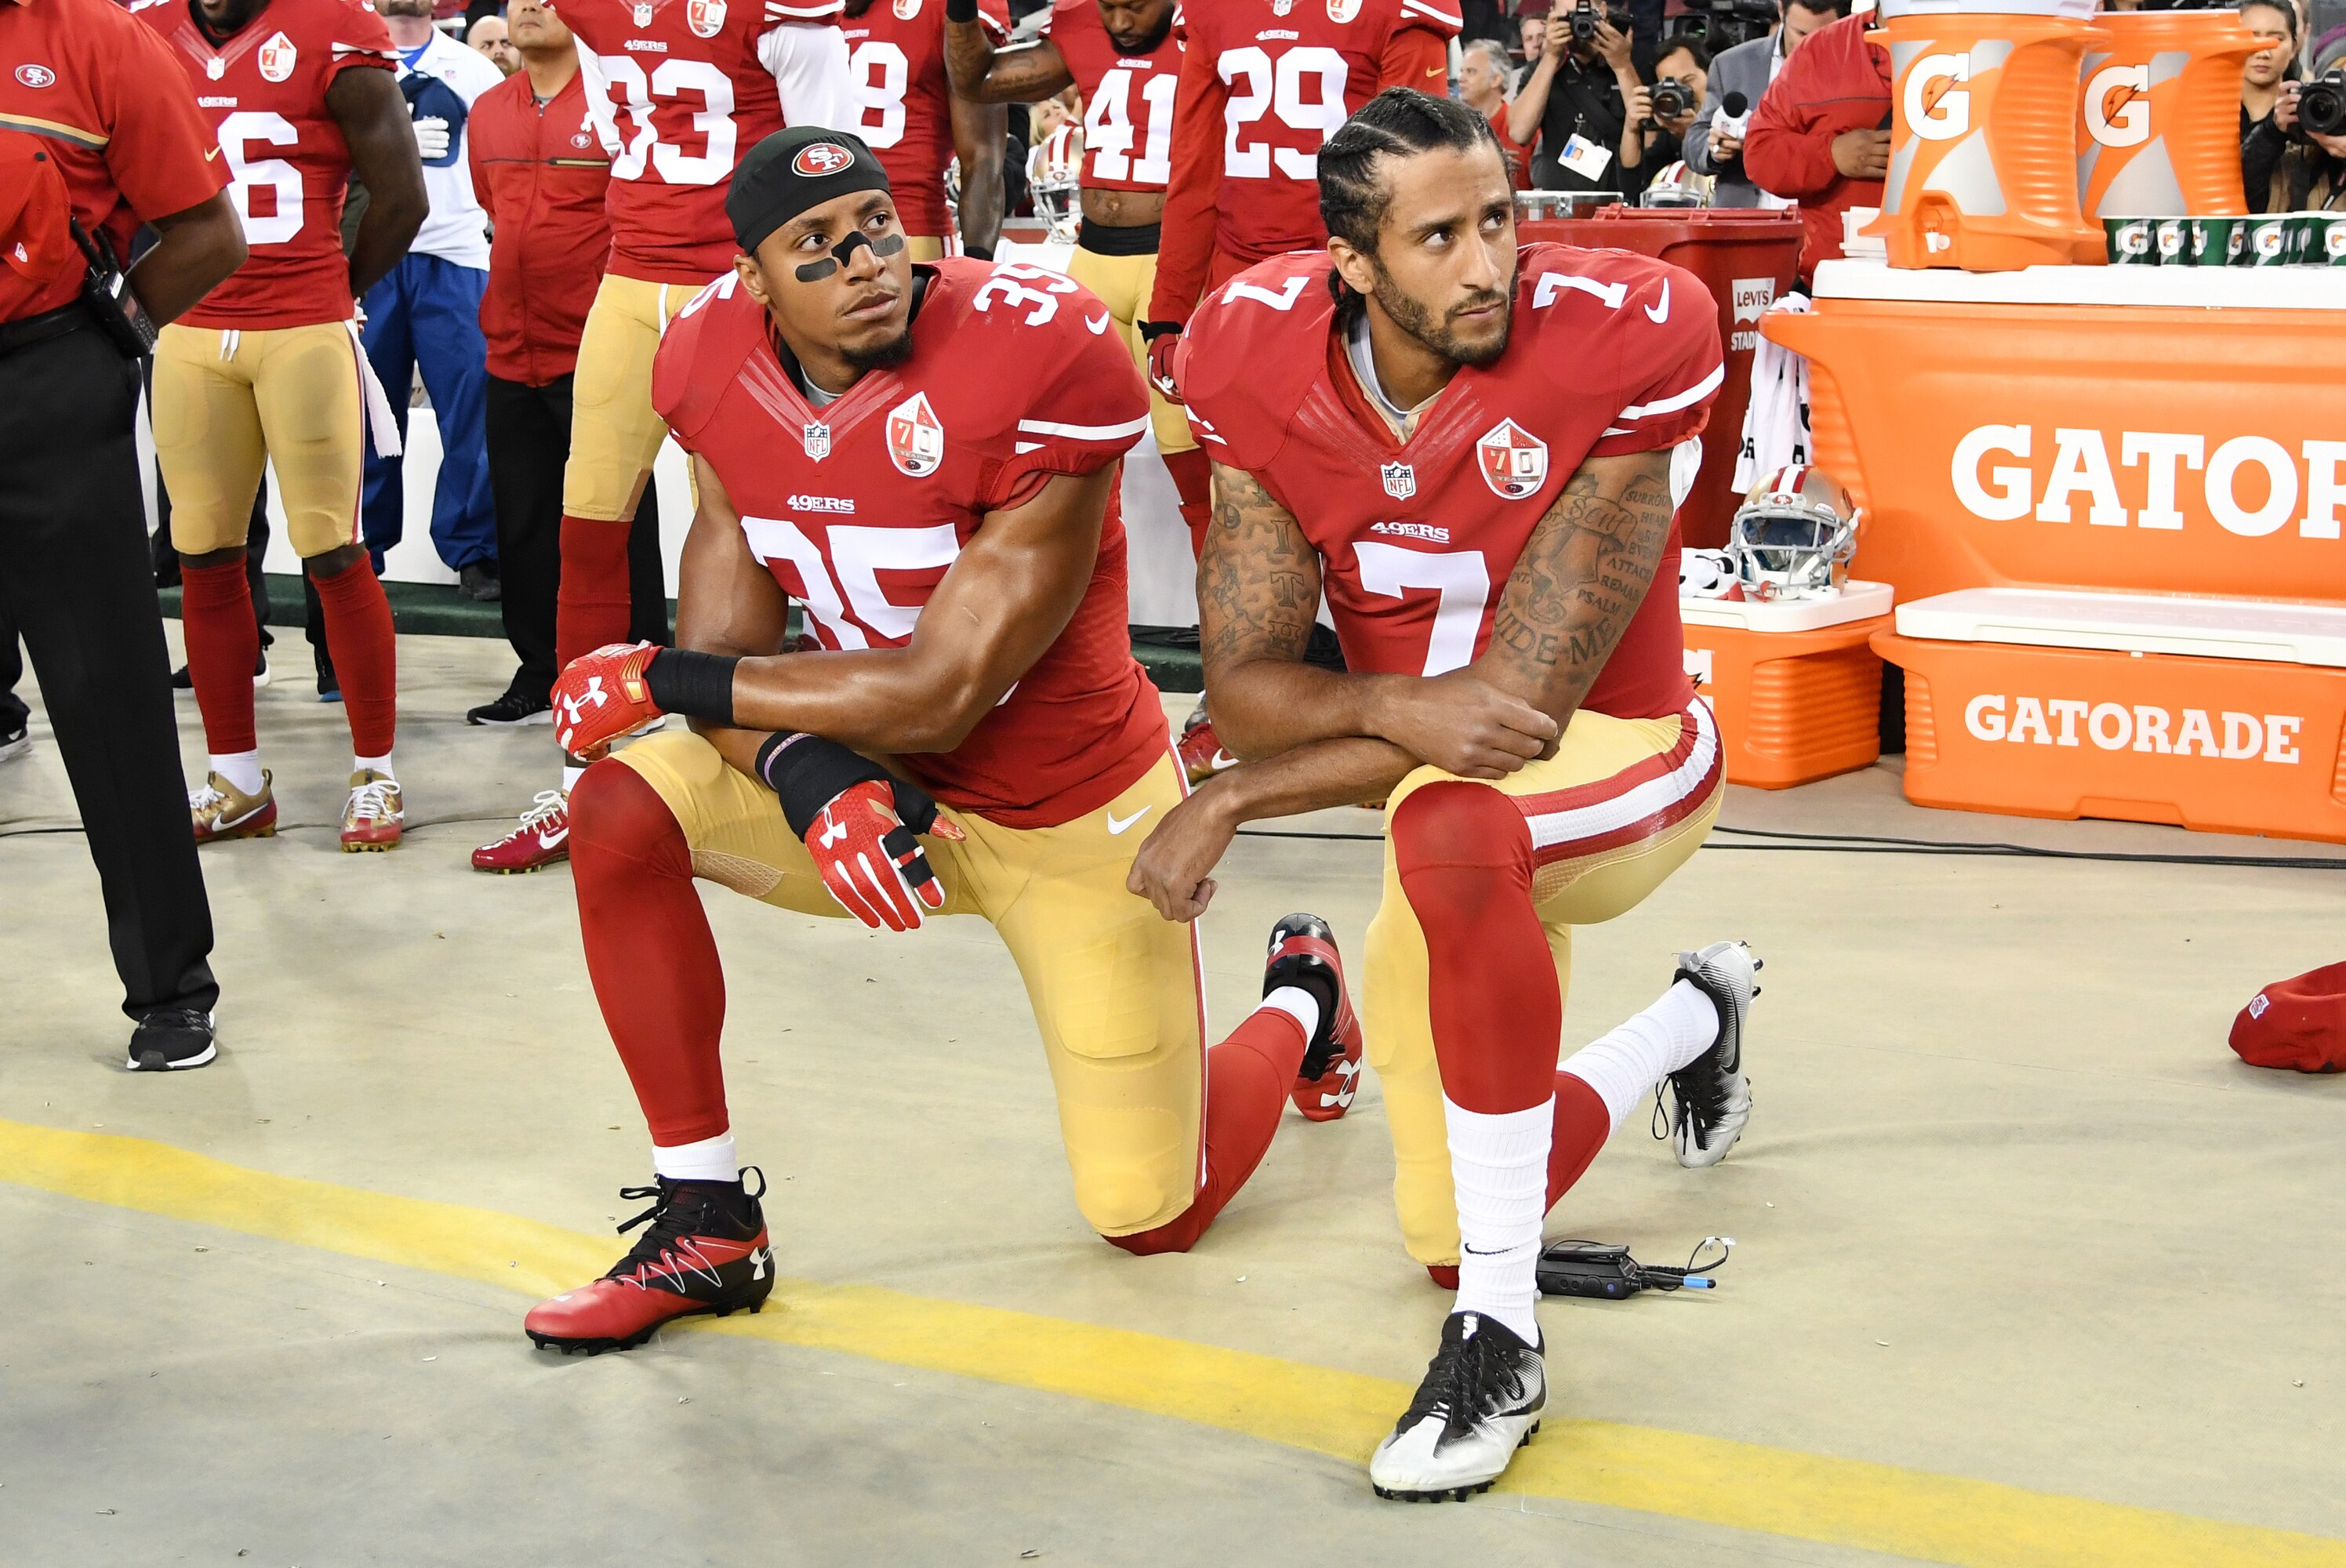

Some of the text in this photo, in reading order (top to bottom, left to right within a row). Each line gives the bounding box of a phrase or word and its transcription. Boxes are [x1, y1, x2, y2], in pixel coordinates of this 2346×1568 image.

[624, 40, 668, 53] 49ERS
[1217, 46, 1349, 180] 29
[1904, 53, 1970, 140] G
[2084, 64, 2150, 147] G
[1084, 69, 1178, 183] 41
[2120, 227, 2148, 255] G
[2256, 227, 2282, 256] G
[972, 263, 1080, 326] 35
[1533, 272, 1629, 309] 7
[808, 438, 826, 454] NFL
[786, 495, 855, 514] 49ERS
[1389, 478, 1411, 494] NFL
[1370, 522, 1450, 543] 49ERS
[1353, 542, 1490, 677] 7
[1964, 693, 2300, 764] GATORADE
